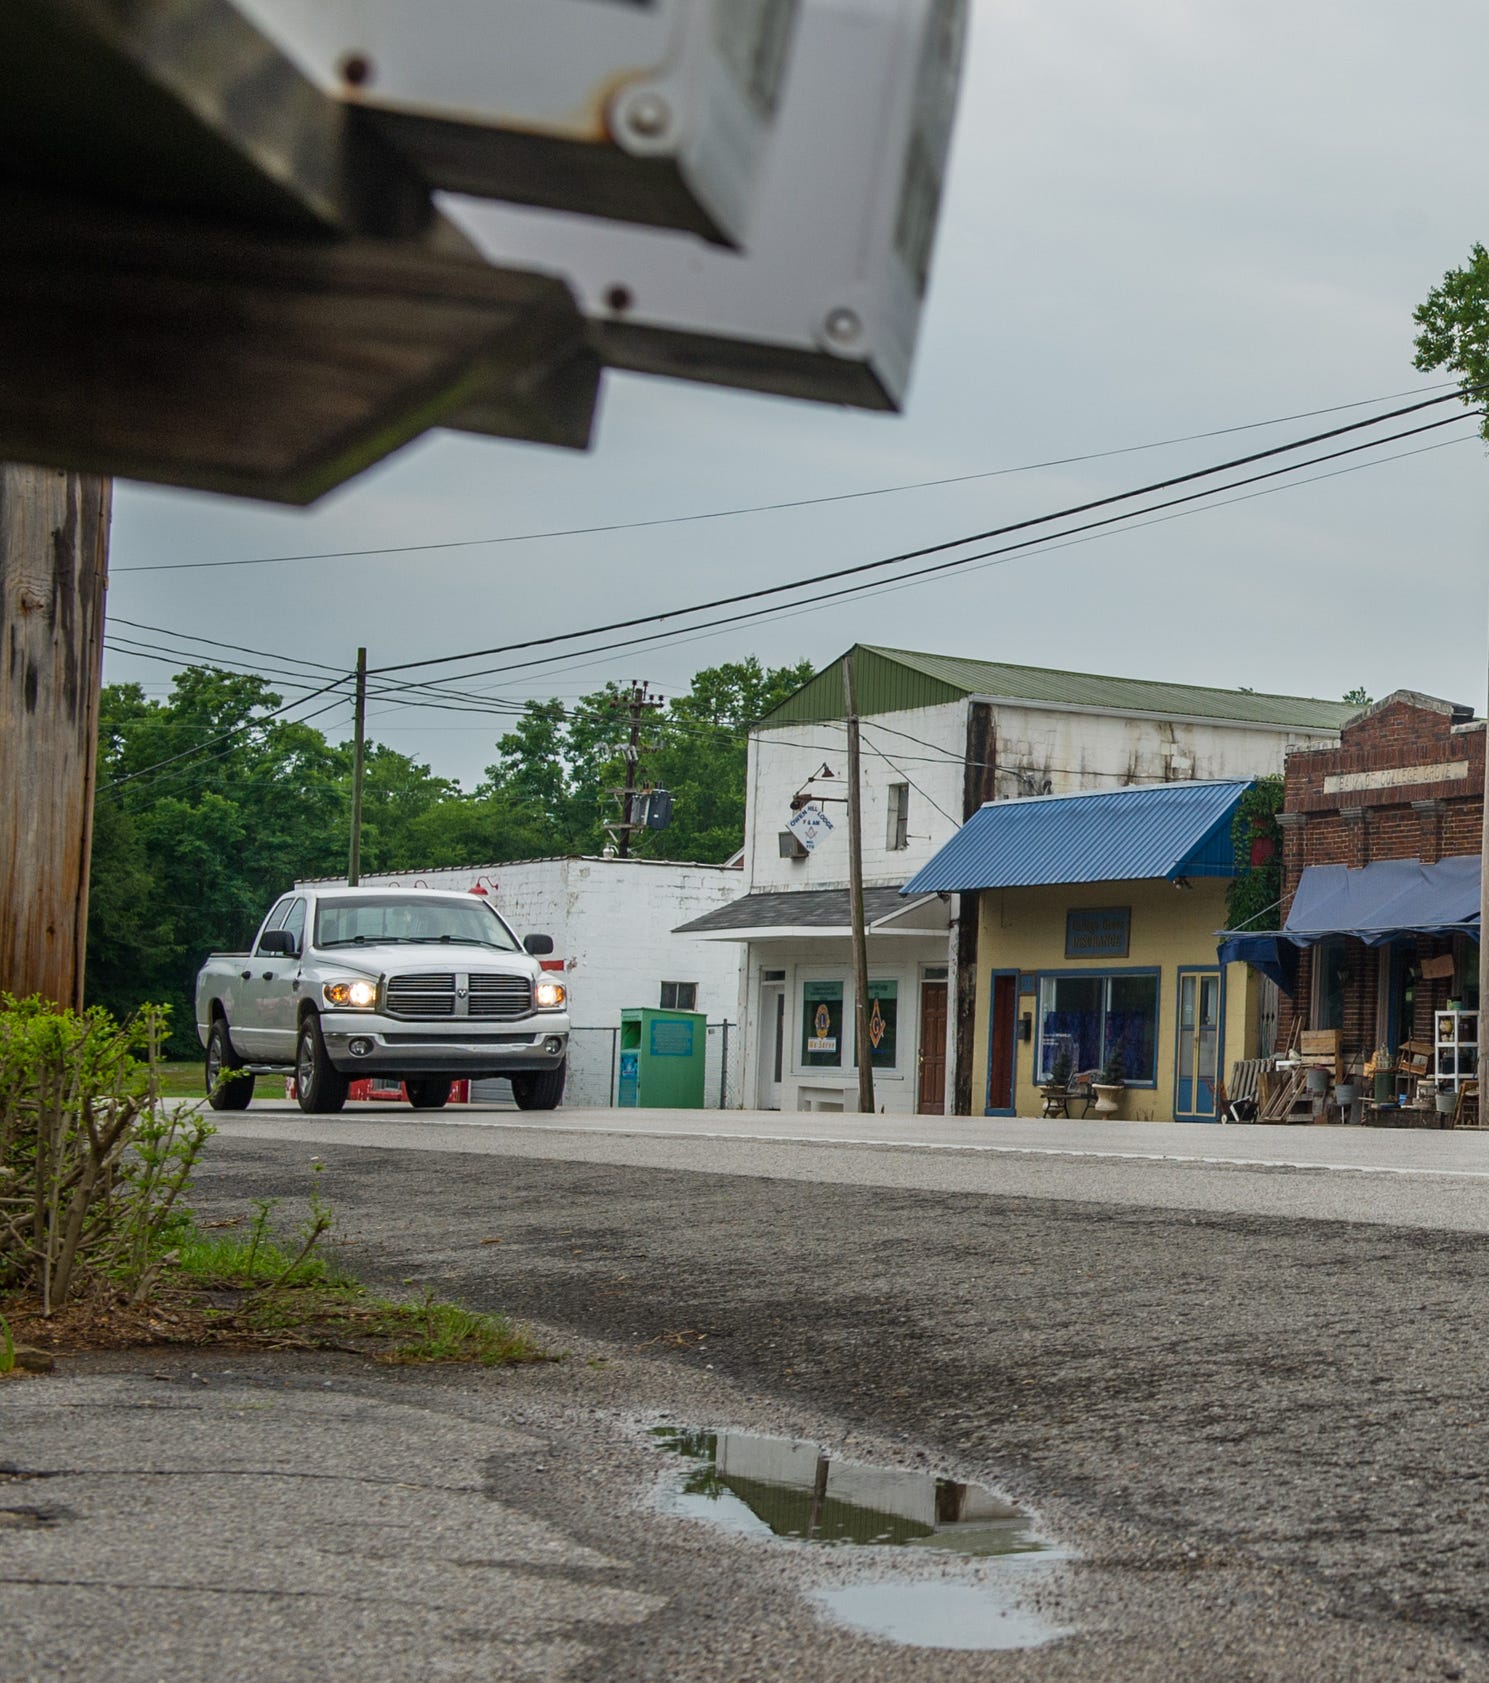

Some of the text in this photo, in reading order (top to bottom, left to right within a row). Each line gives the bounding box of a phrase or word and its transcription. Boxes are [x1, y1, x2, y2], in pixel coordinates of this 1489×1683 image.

[1381, 767, 1418, 786] COLLEGE
[1424, 764, 1451, 781] GROVE
[790, 810, 808, 827] OWEN
[817, 811, 834, 830] LODGE
